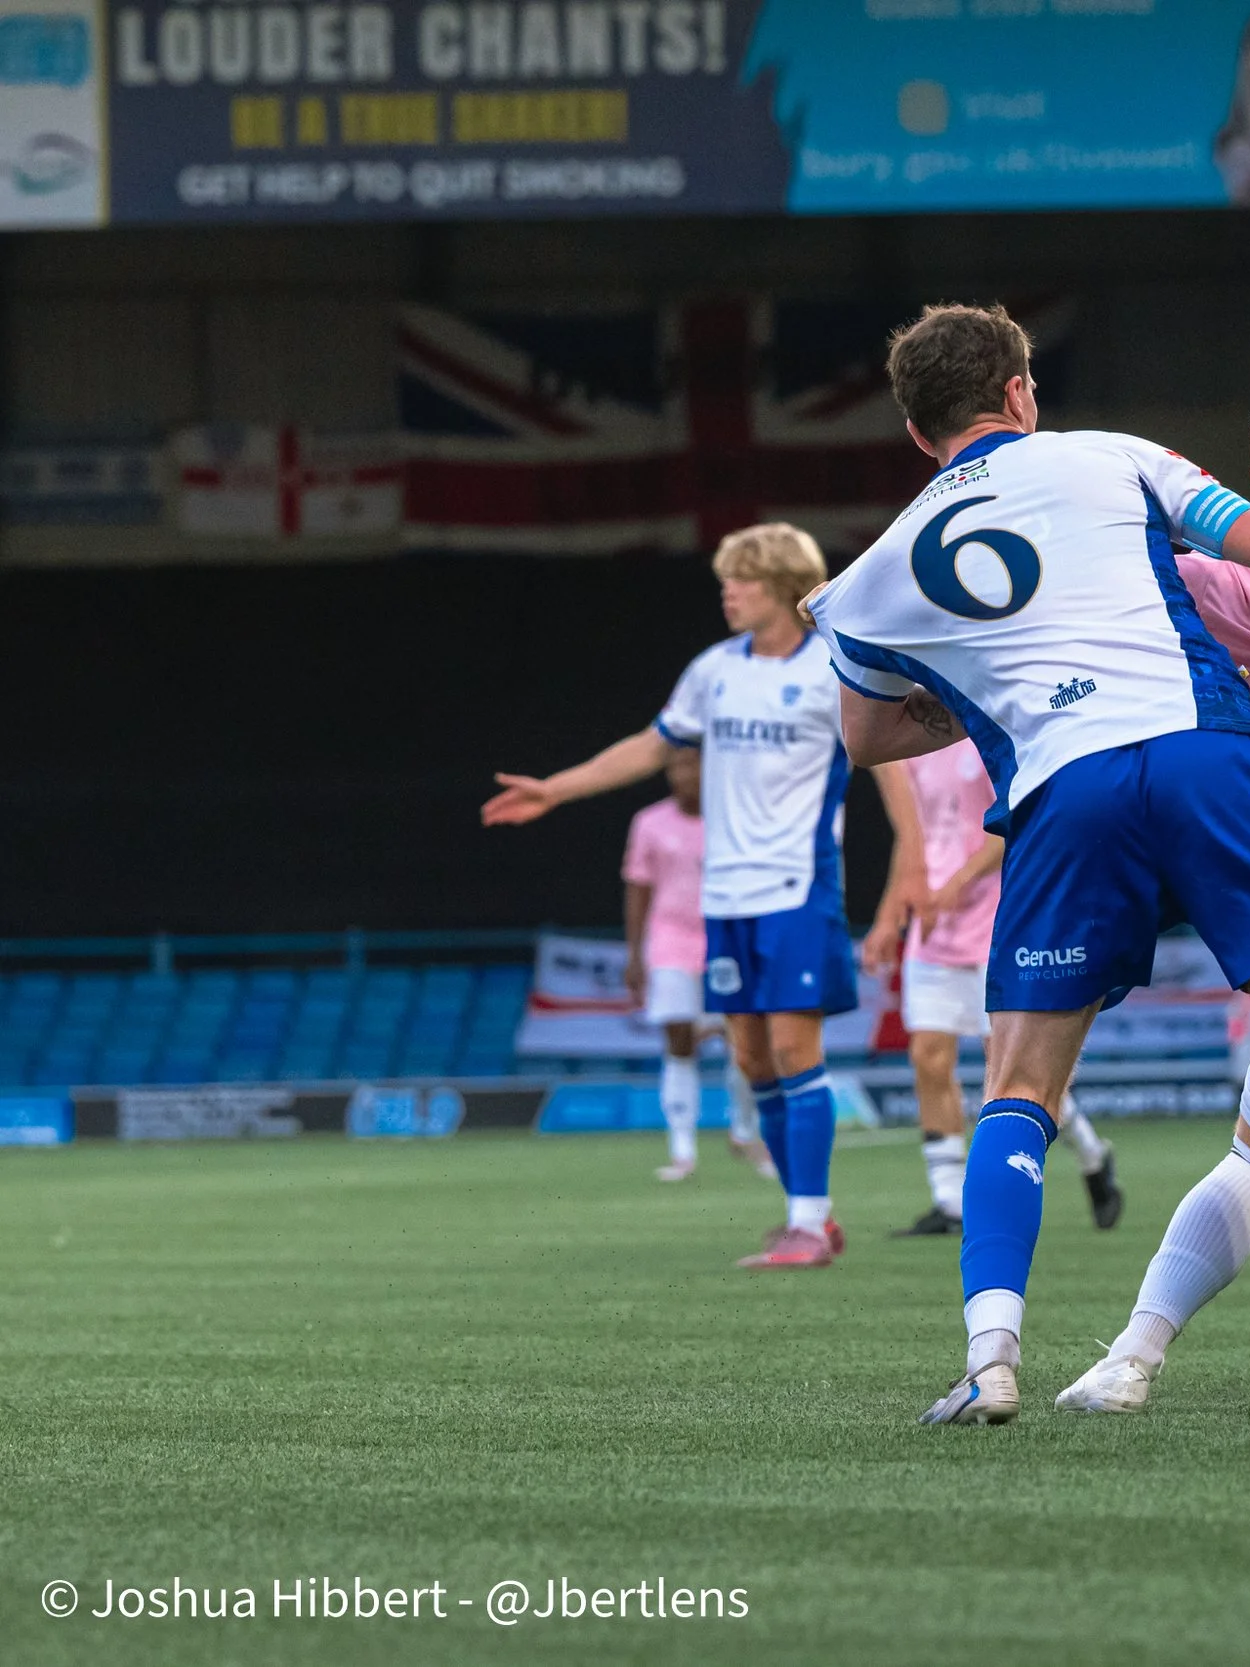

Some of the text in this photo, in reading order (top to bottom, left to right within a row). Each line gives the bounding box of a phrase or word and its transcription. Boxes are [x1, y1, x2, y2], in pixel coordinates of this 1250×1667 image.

[117, 4, 395, 86] LOUDER
[418, 0, 729, 78] CHANTS!
[296, 96, 328, 145] A
[177, 158, 687, 204] GET HELP TO QUIT SMOKING
[910, 495, 1043, 622] 6
[1049, 678, 1097, 709] SHAKERS
[1015, 946, 1087, 968] Genus
[1018, 966, 1088, 981] RECYCLING
